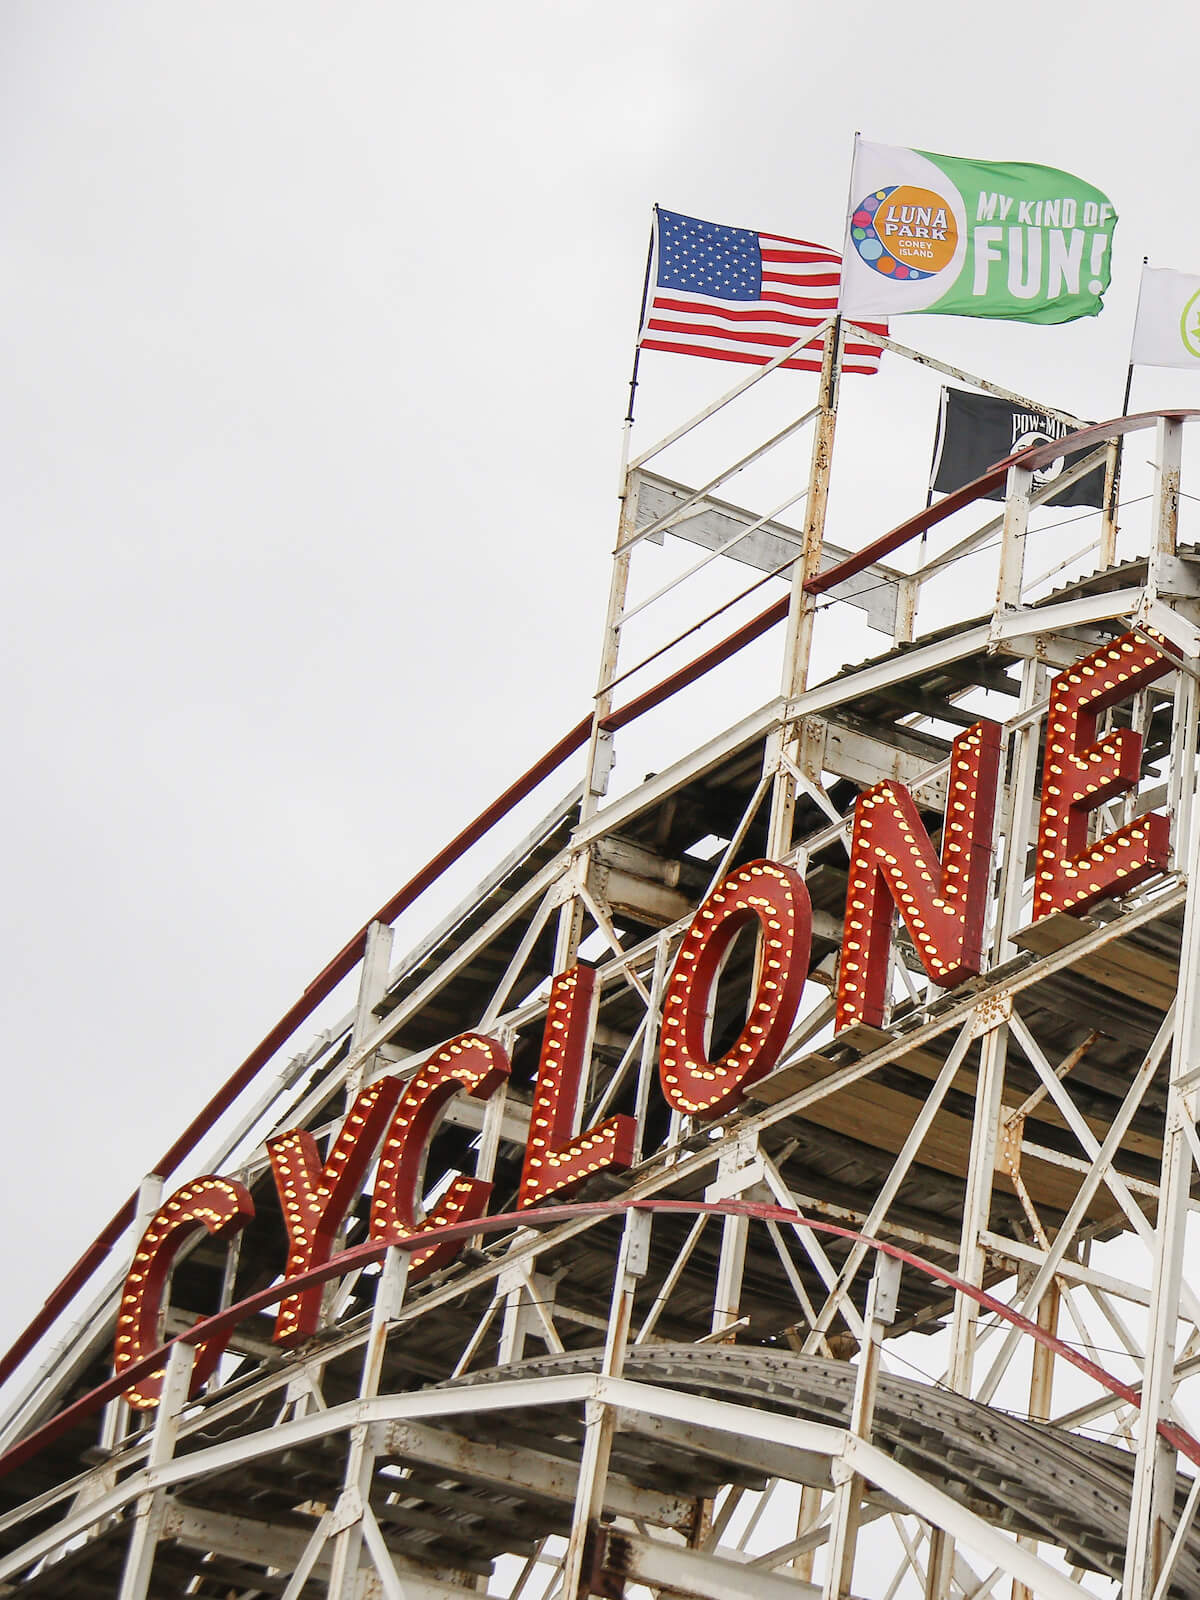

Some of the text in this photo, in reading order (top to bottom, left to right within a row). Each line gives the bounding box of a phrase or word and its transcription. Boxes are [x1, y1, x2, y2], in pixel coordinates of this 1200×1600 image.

[886, 205, 948, 228] LUNA
[976, 191, 1114, 228] MY KIND OF
[884, 223, 948, 241] PARK
[898, 239, 932, 250] CONEY
[898, 249, 934, 259] ISLAND
[972, 226, 1108, 300] FUN!
[1012, 413, 1067, 445] POW MIA
[114, 622, 1183, 1410] CYCLONE
